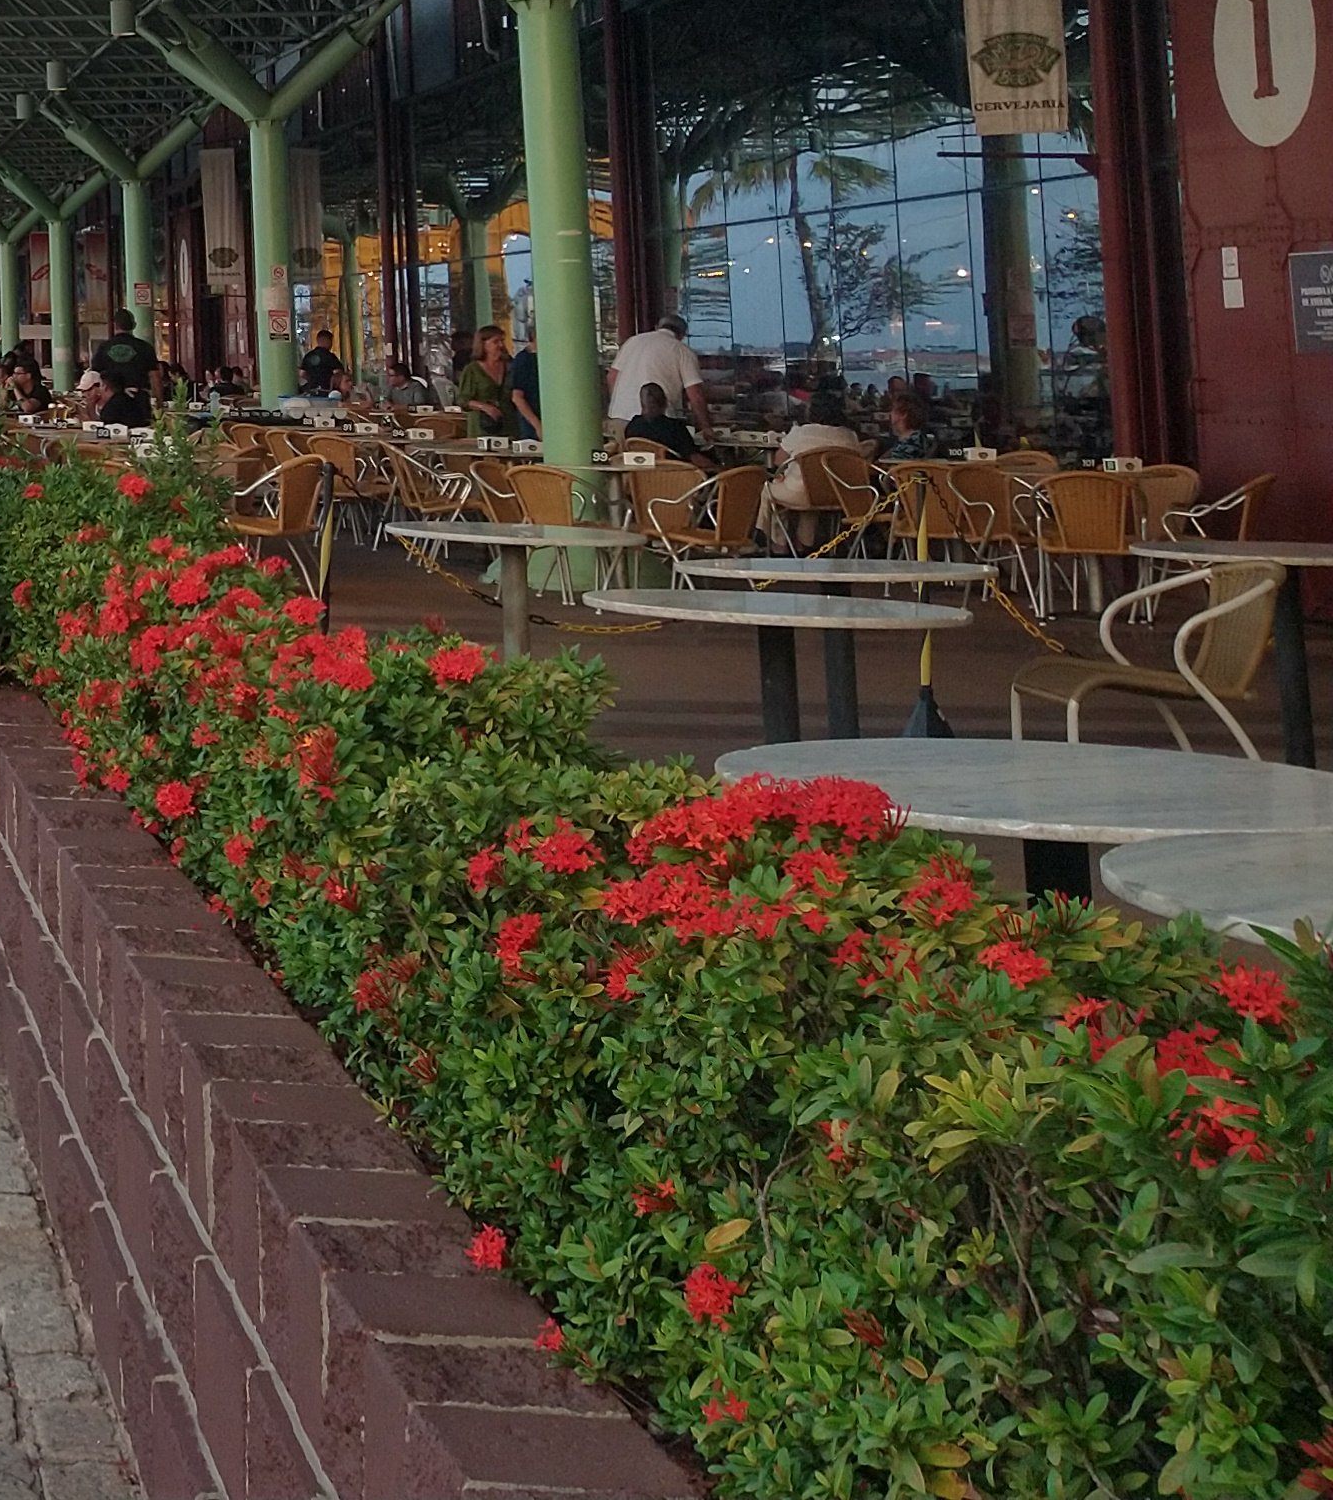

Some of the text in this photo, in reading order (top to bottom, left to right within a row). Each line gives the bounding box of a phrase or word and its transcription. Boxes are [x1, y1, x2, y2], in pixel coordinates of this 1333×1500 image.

[974, 99, 1065, 112] CERVEJARIA
[592, 452, 608, 462] 99
[1082, 459, 1095, 467] 101
